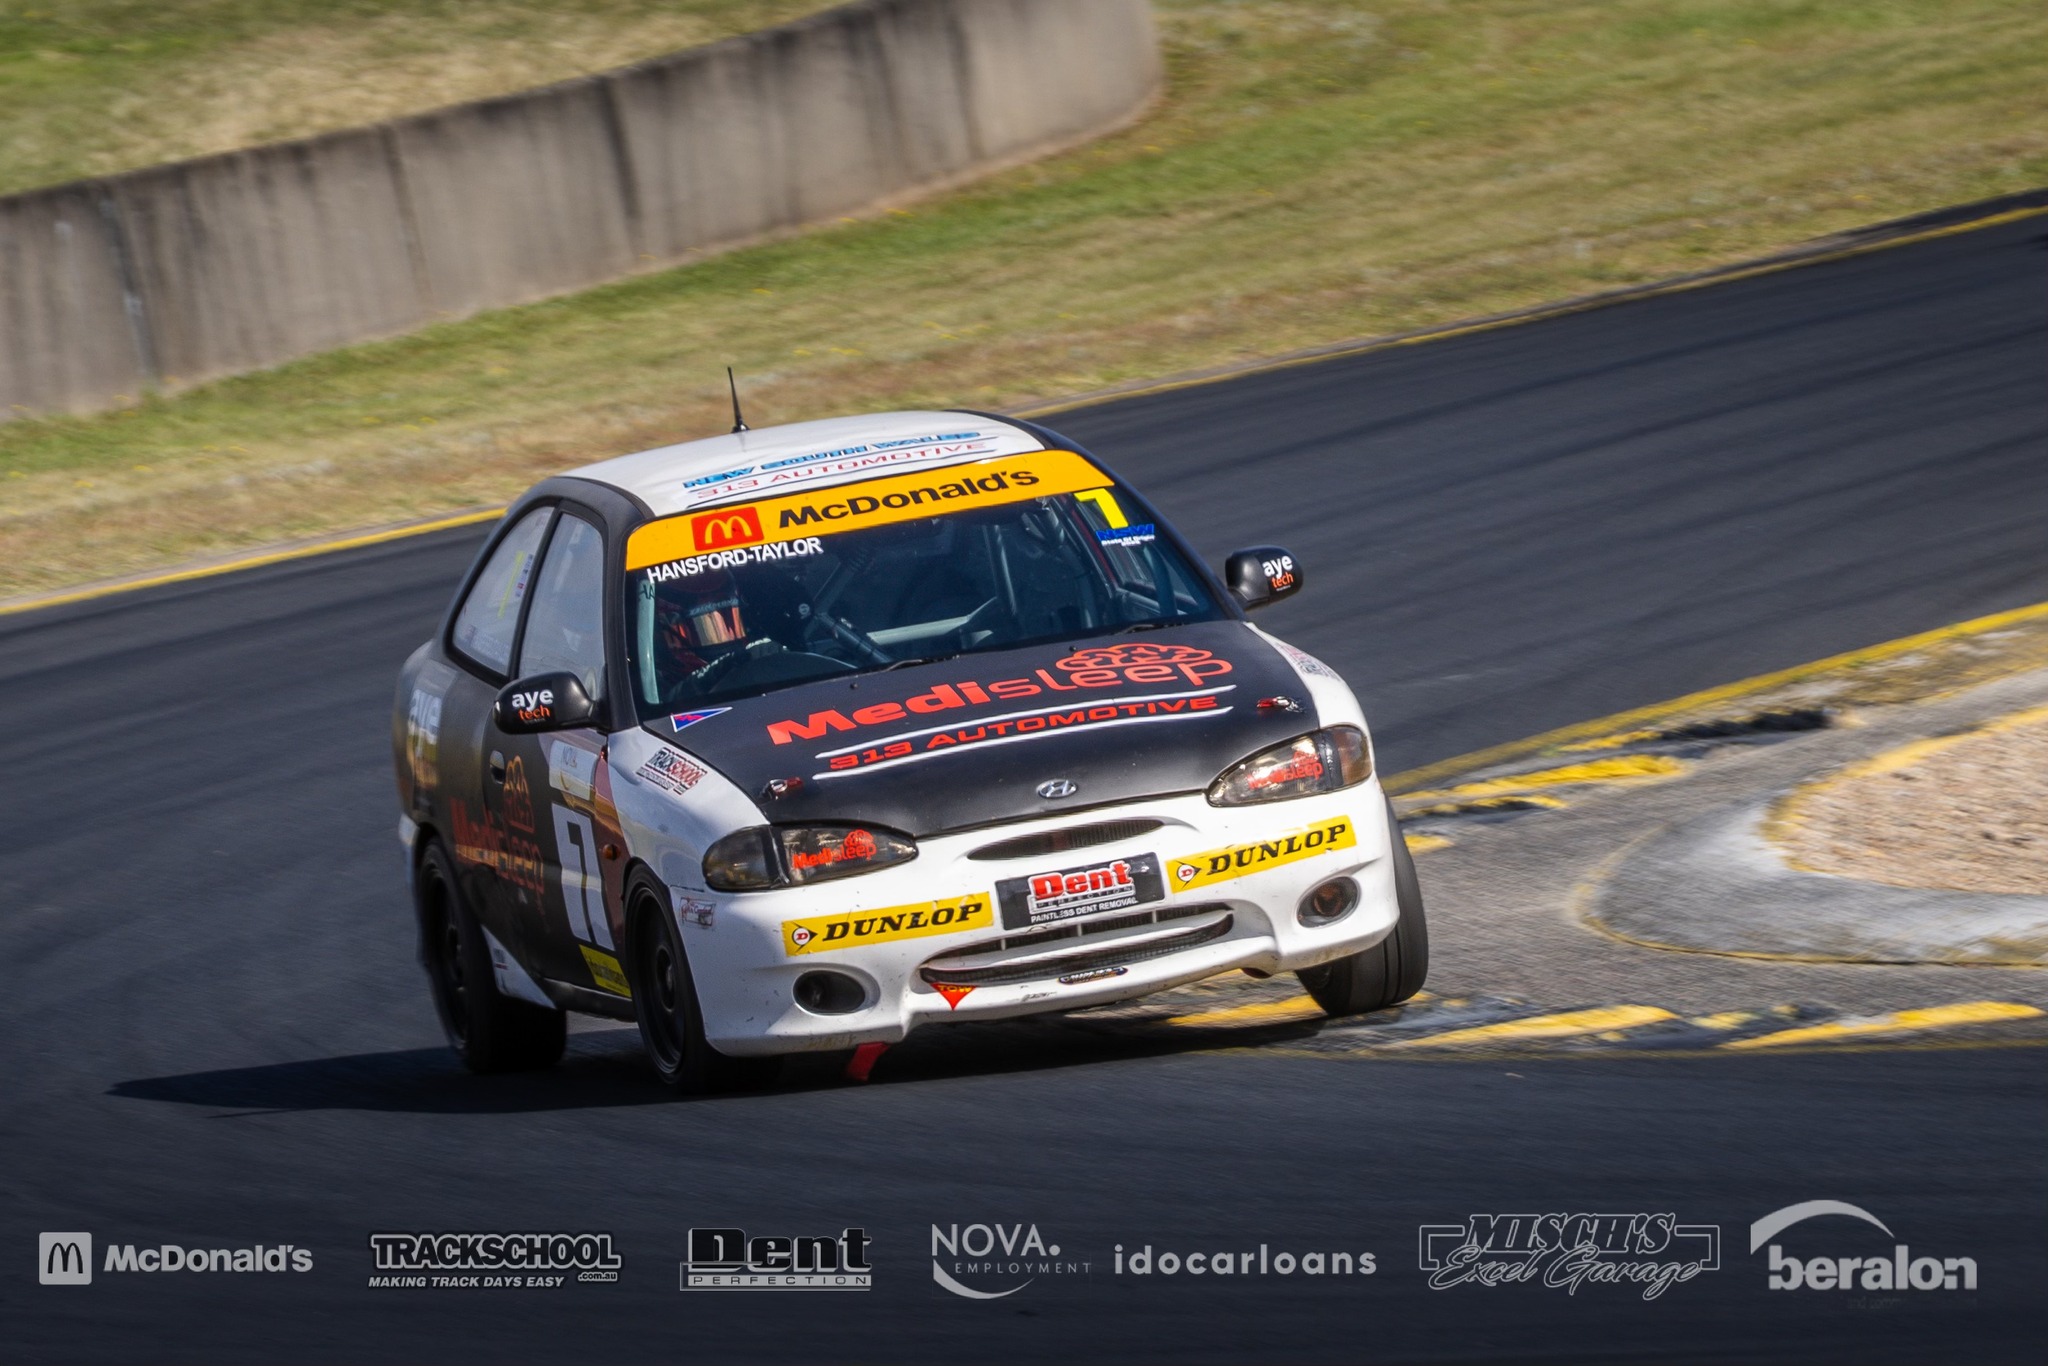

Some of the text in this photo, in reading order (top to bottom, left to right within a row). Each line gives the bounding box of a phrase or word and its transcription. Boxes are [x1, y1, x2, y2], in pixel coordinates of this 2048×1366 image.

[682, 466, 755, 488] NEW
[761, 445, 868, 470] SOUTH
[697, 442, 987, 499] 313 AUTOMOTIVE
[778, 467, 1040, 529] McDonald's
[646, 537, 824, 584] HANSFORD-TAYLOR
[1262, 555, 1293, 580] aye
[1271, 571, 1294, 588] tech
[512, 689, 554, 712] aye
[518, 704, 550, 720] tech
[766, 657, 1233, 746] Medisleep
[829, 695, 1217, 771] 313 AUTOMOTIVE
[792, 841, 876, 870] Medisleep
[1206, 823, 1346, 875] DUNLOP
[1030, 861, 1133, 899] Dent
[822, 902, 982, 941] DUNLOP
[1076, 904, 1098, 916] DENT
[1098, 897, 1138, 910] REMOVAL
[938, 984, 973, 993] TOW
